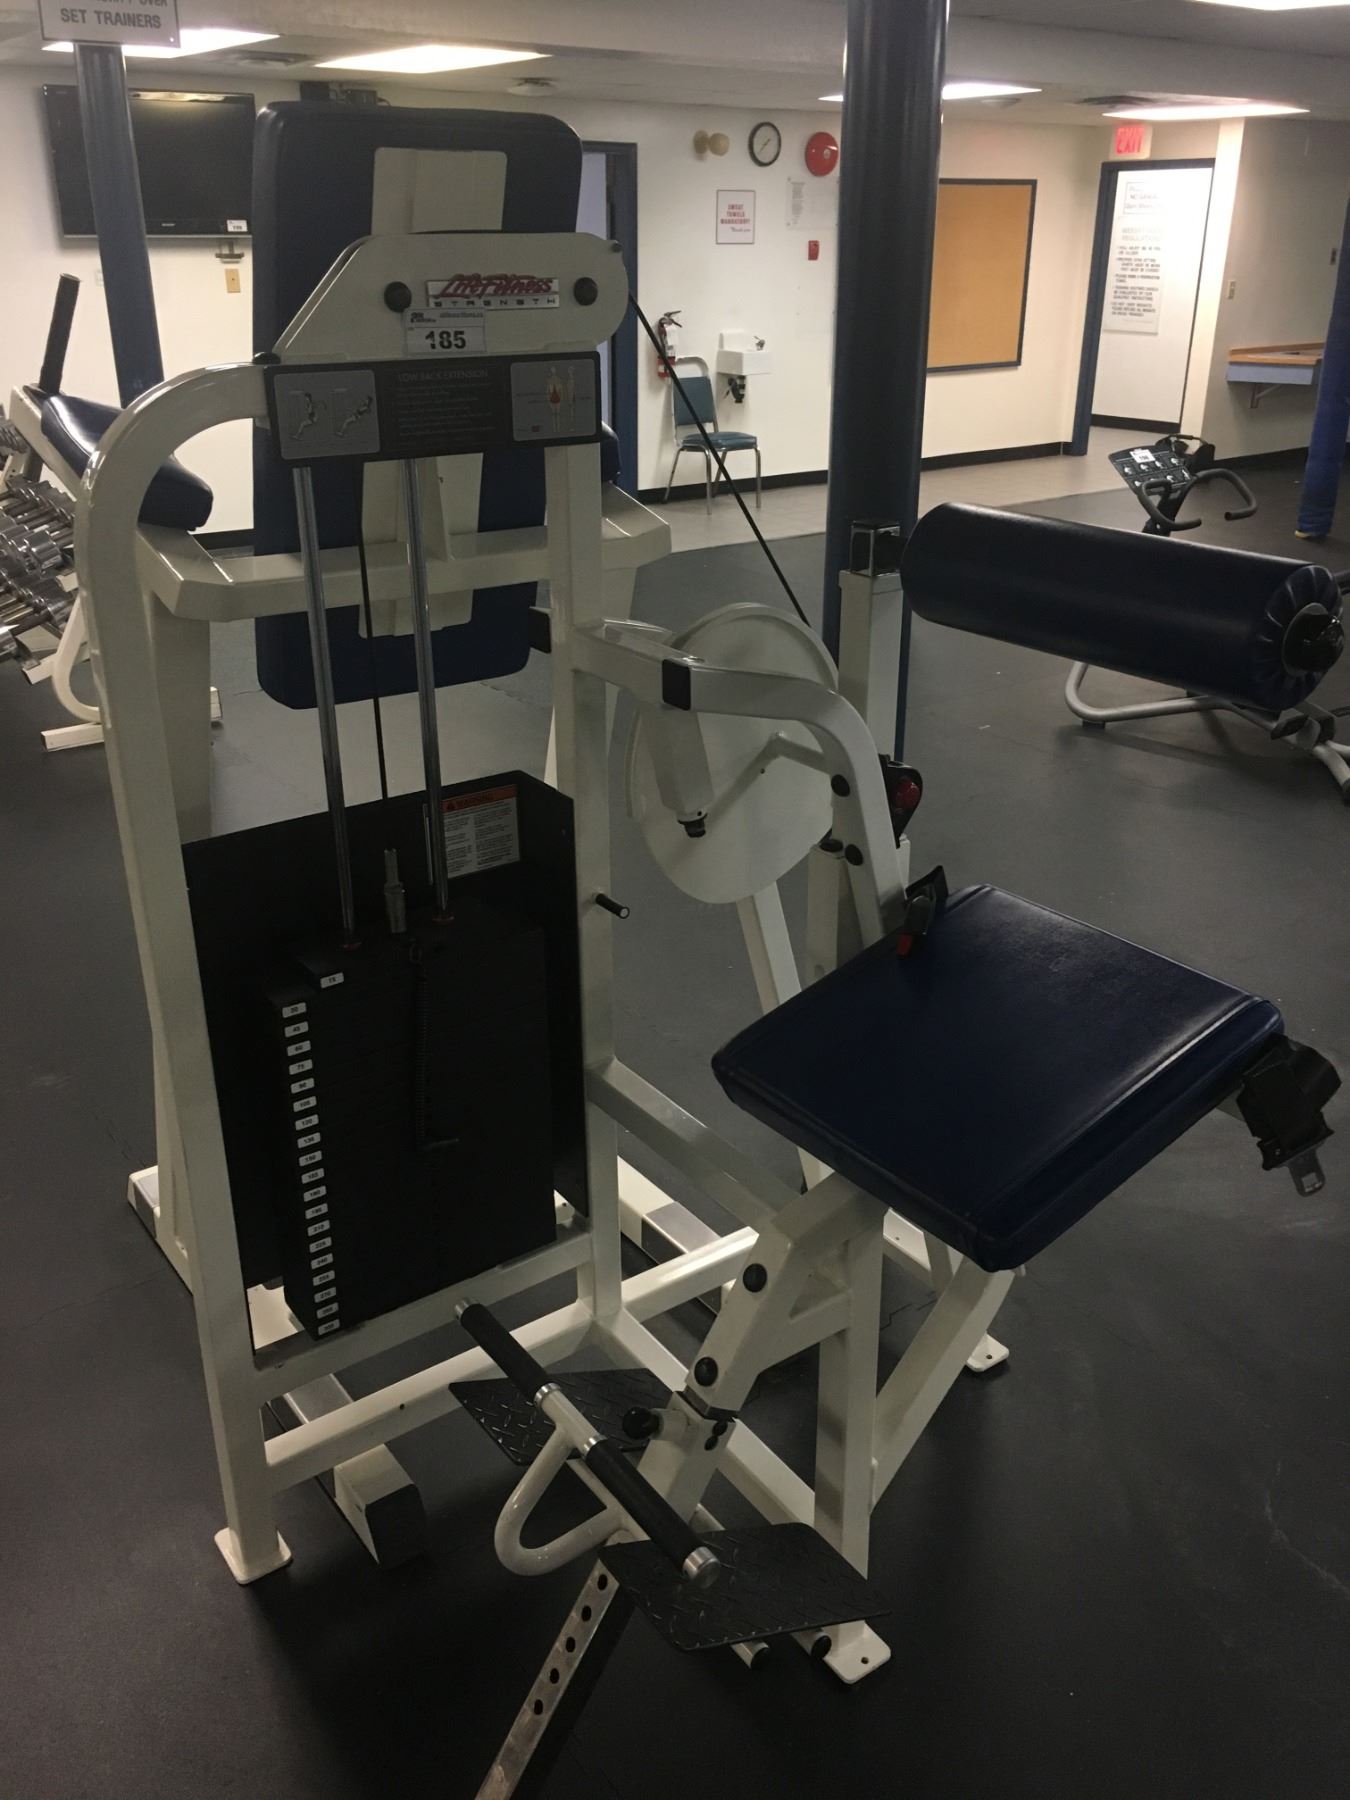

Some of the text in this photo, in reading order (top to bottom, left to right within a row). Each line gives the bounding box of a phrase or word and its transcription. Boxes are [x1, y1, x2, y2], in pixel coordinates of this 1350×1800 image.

[60, 8, 161, 29] SET TRAINERS
[1116, 126, 1145, 155] EXIT
[433, 298, 556, 308] STRENGTH
[424, 330, 467, 350] 185
